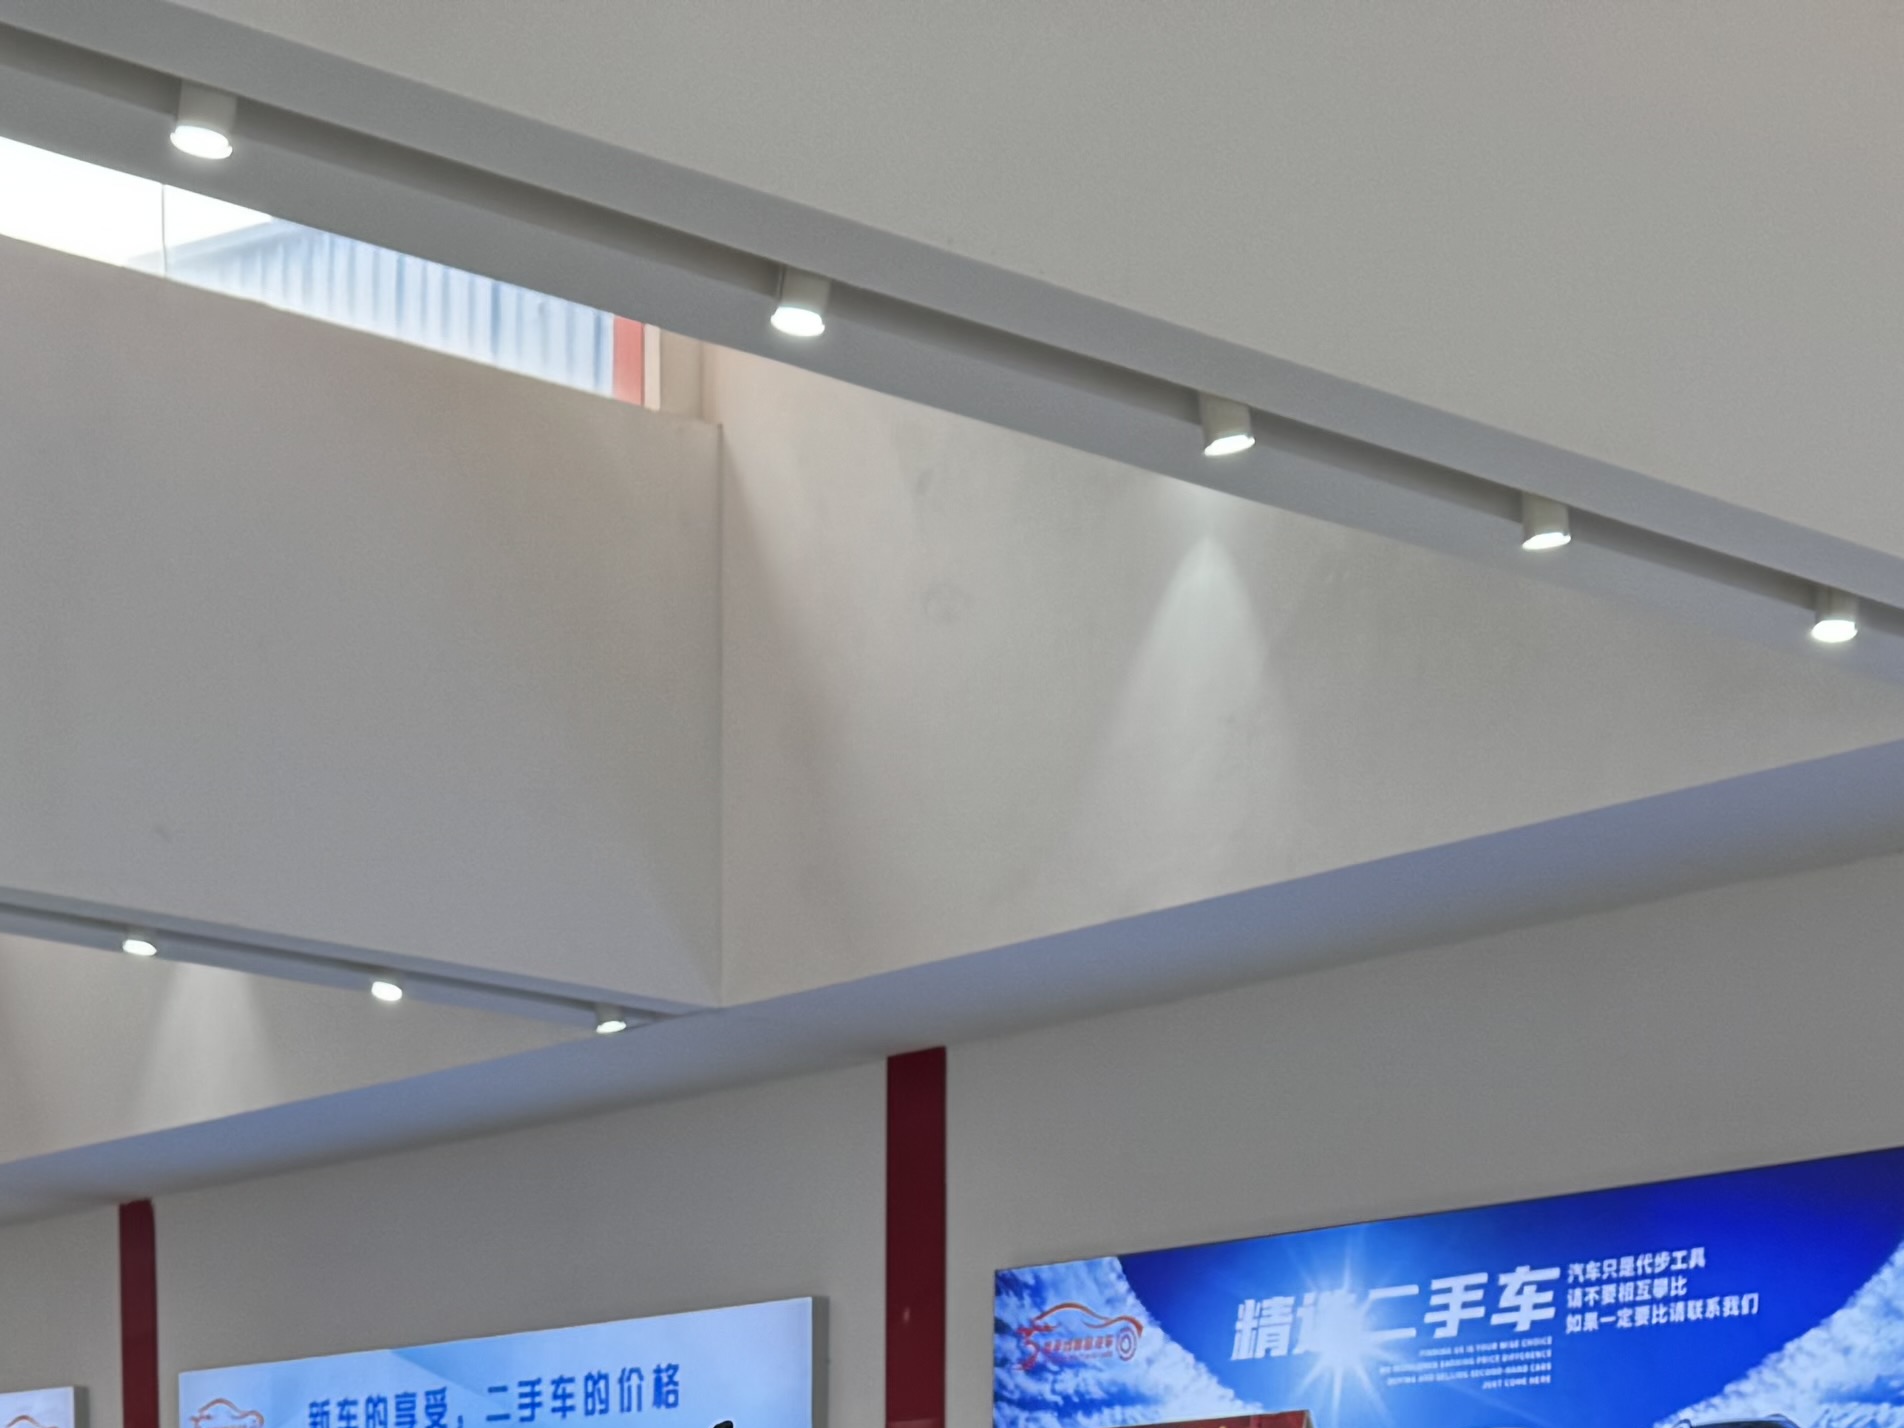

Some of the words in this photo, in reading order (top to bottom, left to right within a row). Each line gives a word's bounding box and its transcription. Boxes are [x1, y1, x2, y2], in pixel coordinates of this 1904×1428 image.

[1567, 1246, 1706, 1284] 汽车只是代步工具
[1565, 1292, 1760, 1335] 如果一定要比请联系我们
